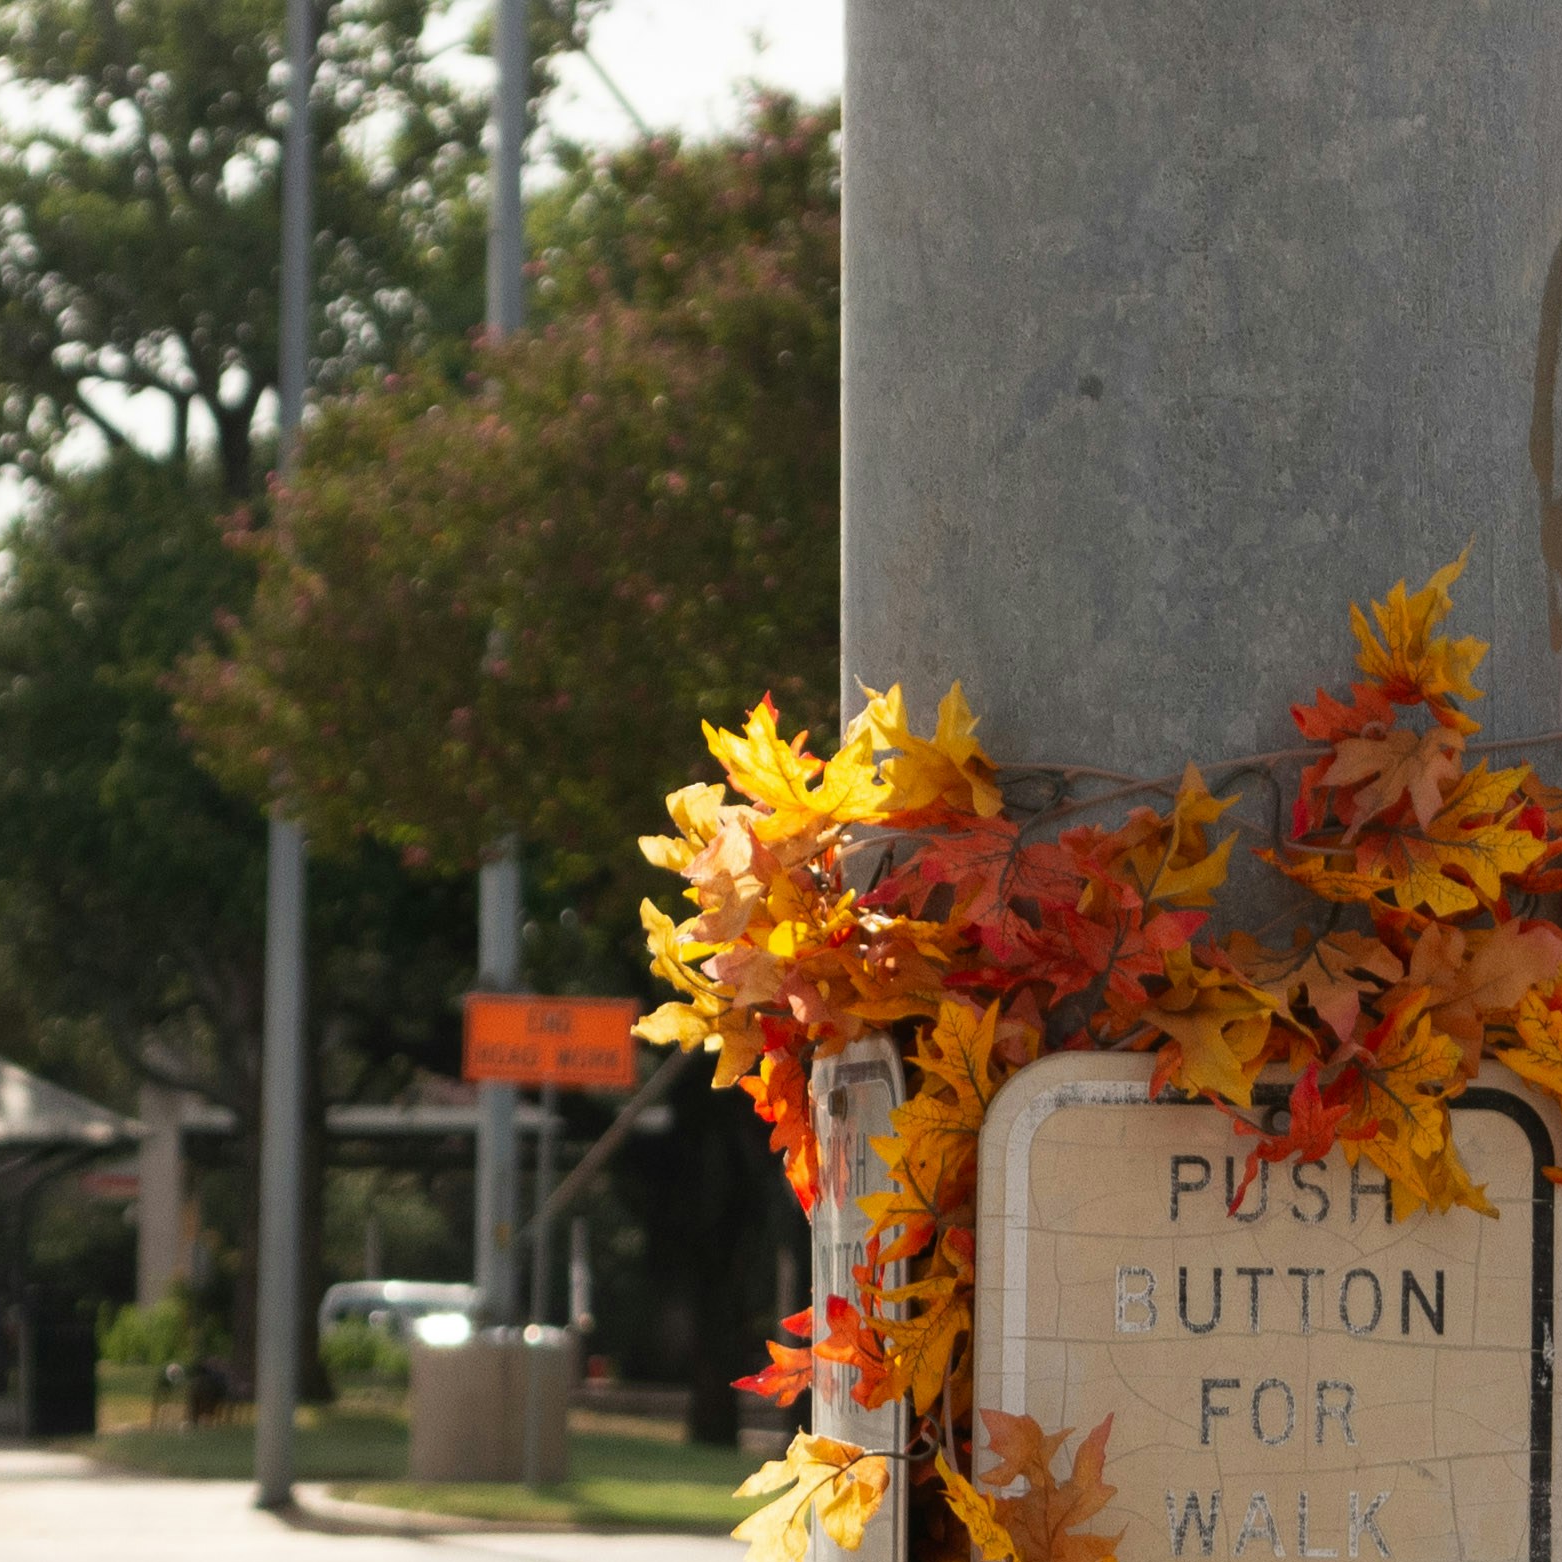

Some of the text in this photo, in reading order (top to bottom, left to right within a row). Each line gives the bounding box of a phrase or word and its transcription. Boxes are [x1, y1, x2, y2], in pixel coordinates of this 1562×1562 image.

[1169, 1154, 1394, 1224] PUSH
[1114, 1266, 1445, 1337] BUTTON
[1200, 1377, 1359, 1446] FOR
[1164, 1488, 1392, 1559] WALK
